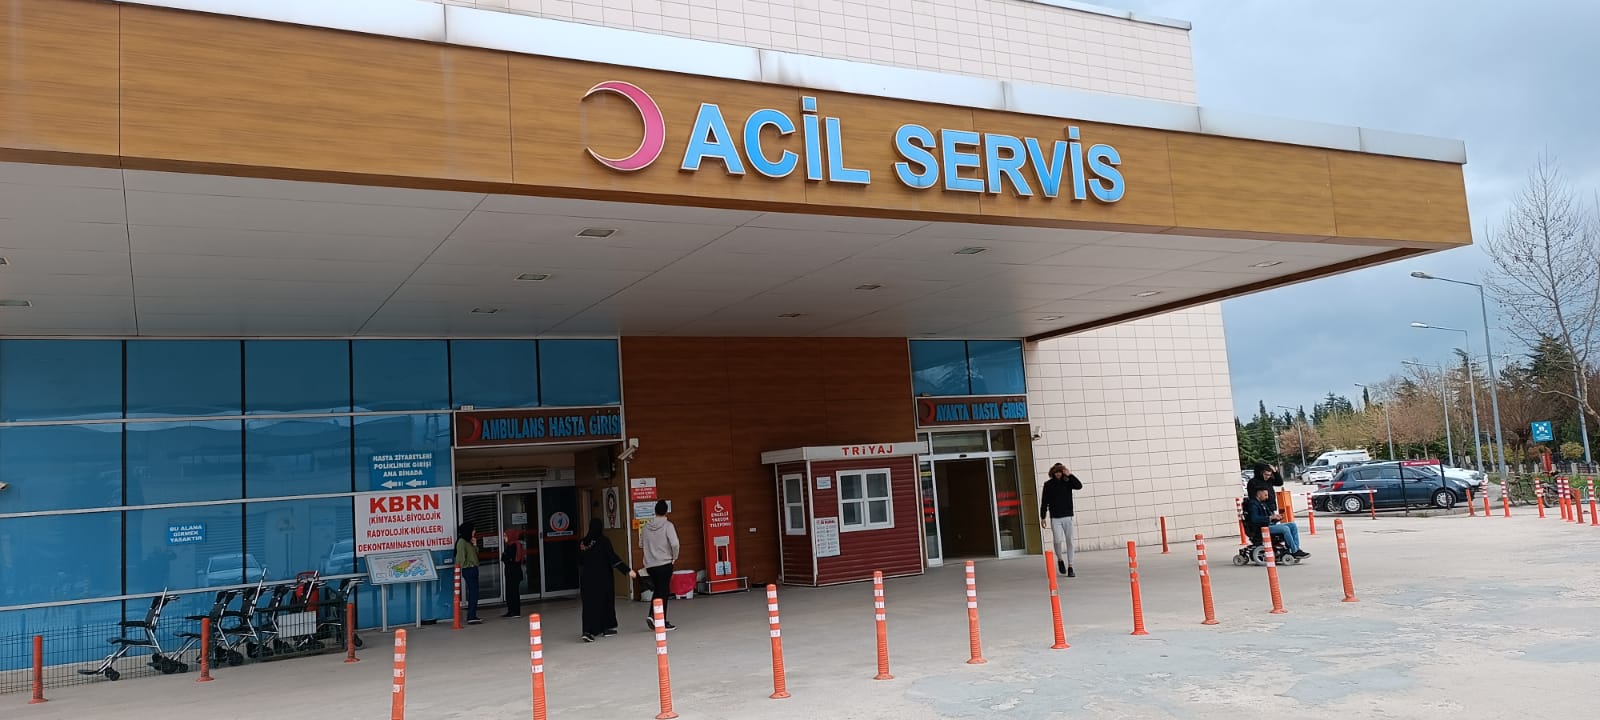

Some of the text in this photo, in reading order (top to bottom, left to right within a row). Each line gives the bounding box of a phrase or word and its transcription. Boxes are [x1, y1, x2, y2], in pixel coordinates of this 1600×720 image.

[680, 96, 1126, 203] ACİL SERVİS
[936, 403, 970, 422] AYAKTA
[972, 402, 1001, 420] HASTA
[482, 417, 545, 440] AMBULANS
[550, 416, 586, 437] HASTA
[369, 493, 440, 514] KBRN
[358, 538, 425, 553] DEKONTAMİNASYON
